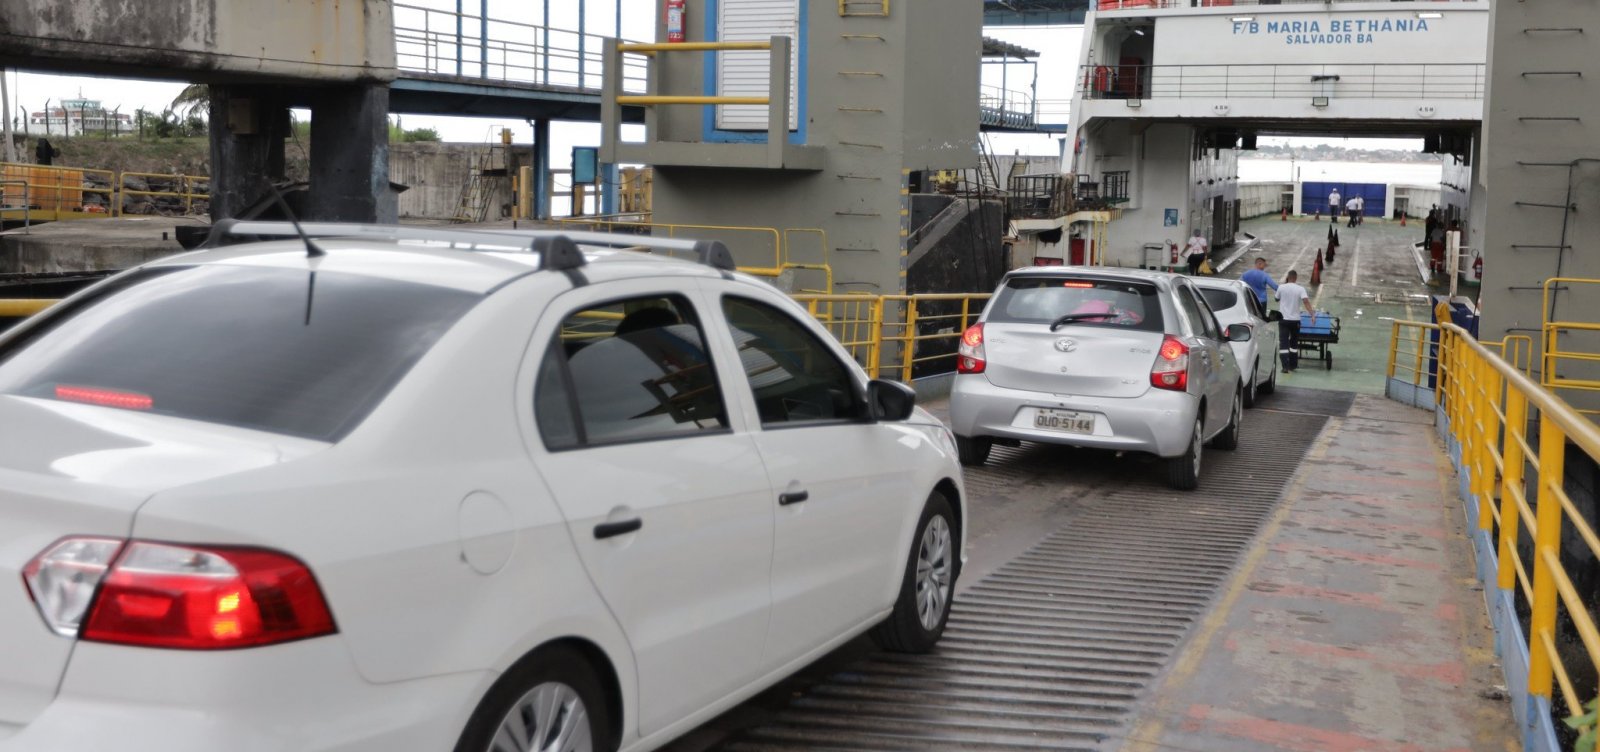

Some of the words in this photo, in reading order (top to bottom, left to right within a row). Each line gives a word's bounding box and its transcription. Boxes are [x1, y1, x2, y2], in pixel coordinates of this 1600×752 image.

[1233, 21, 1259, 34] F/B
[1267, 20, 1320, 33] MARIA
[1286, 33, 1352, 45] SALVADOR
[1357, 32, 1374, 44] BA
